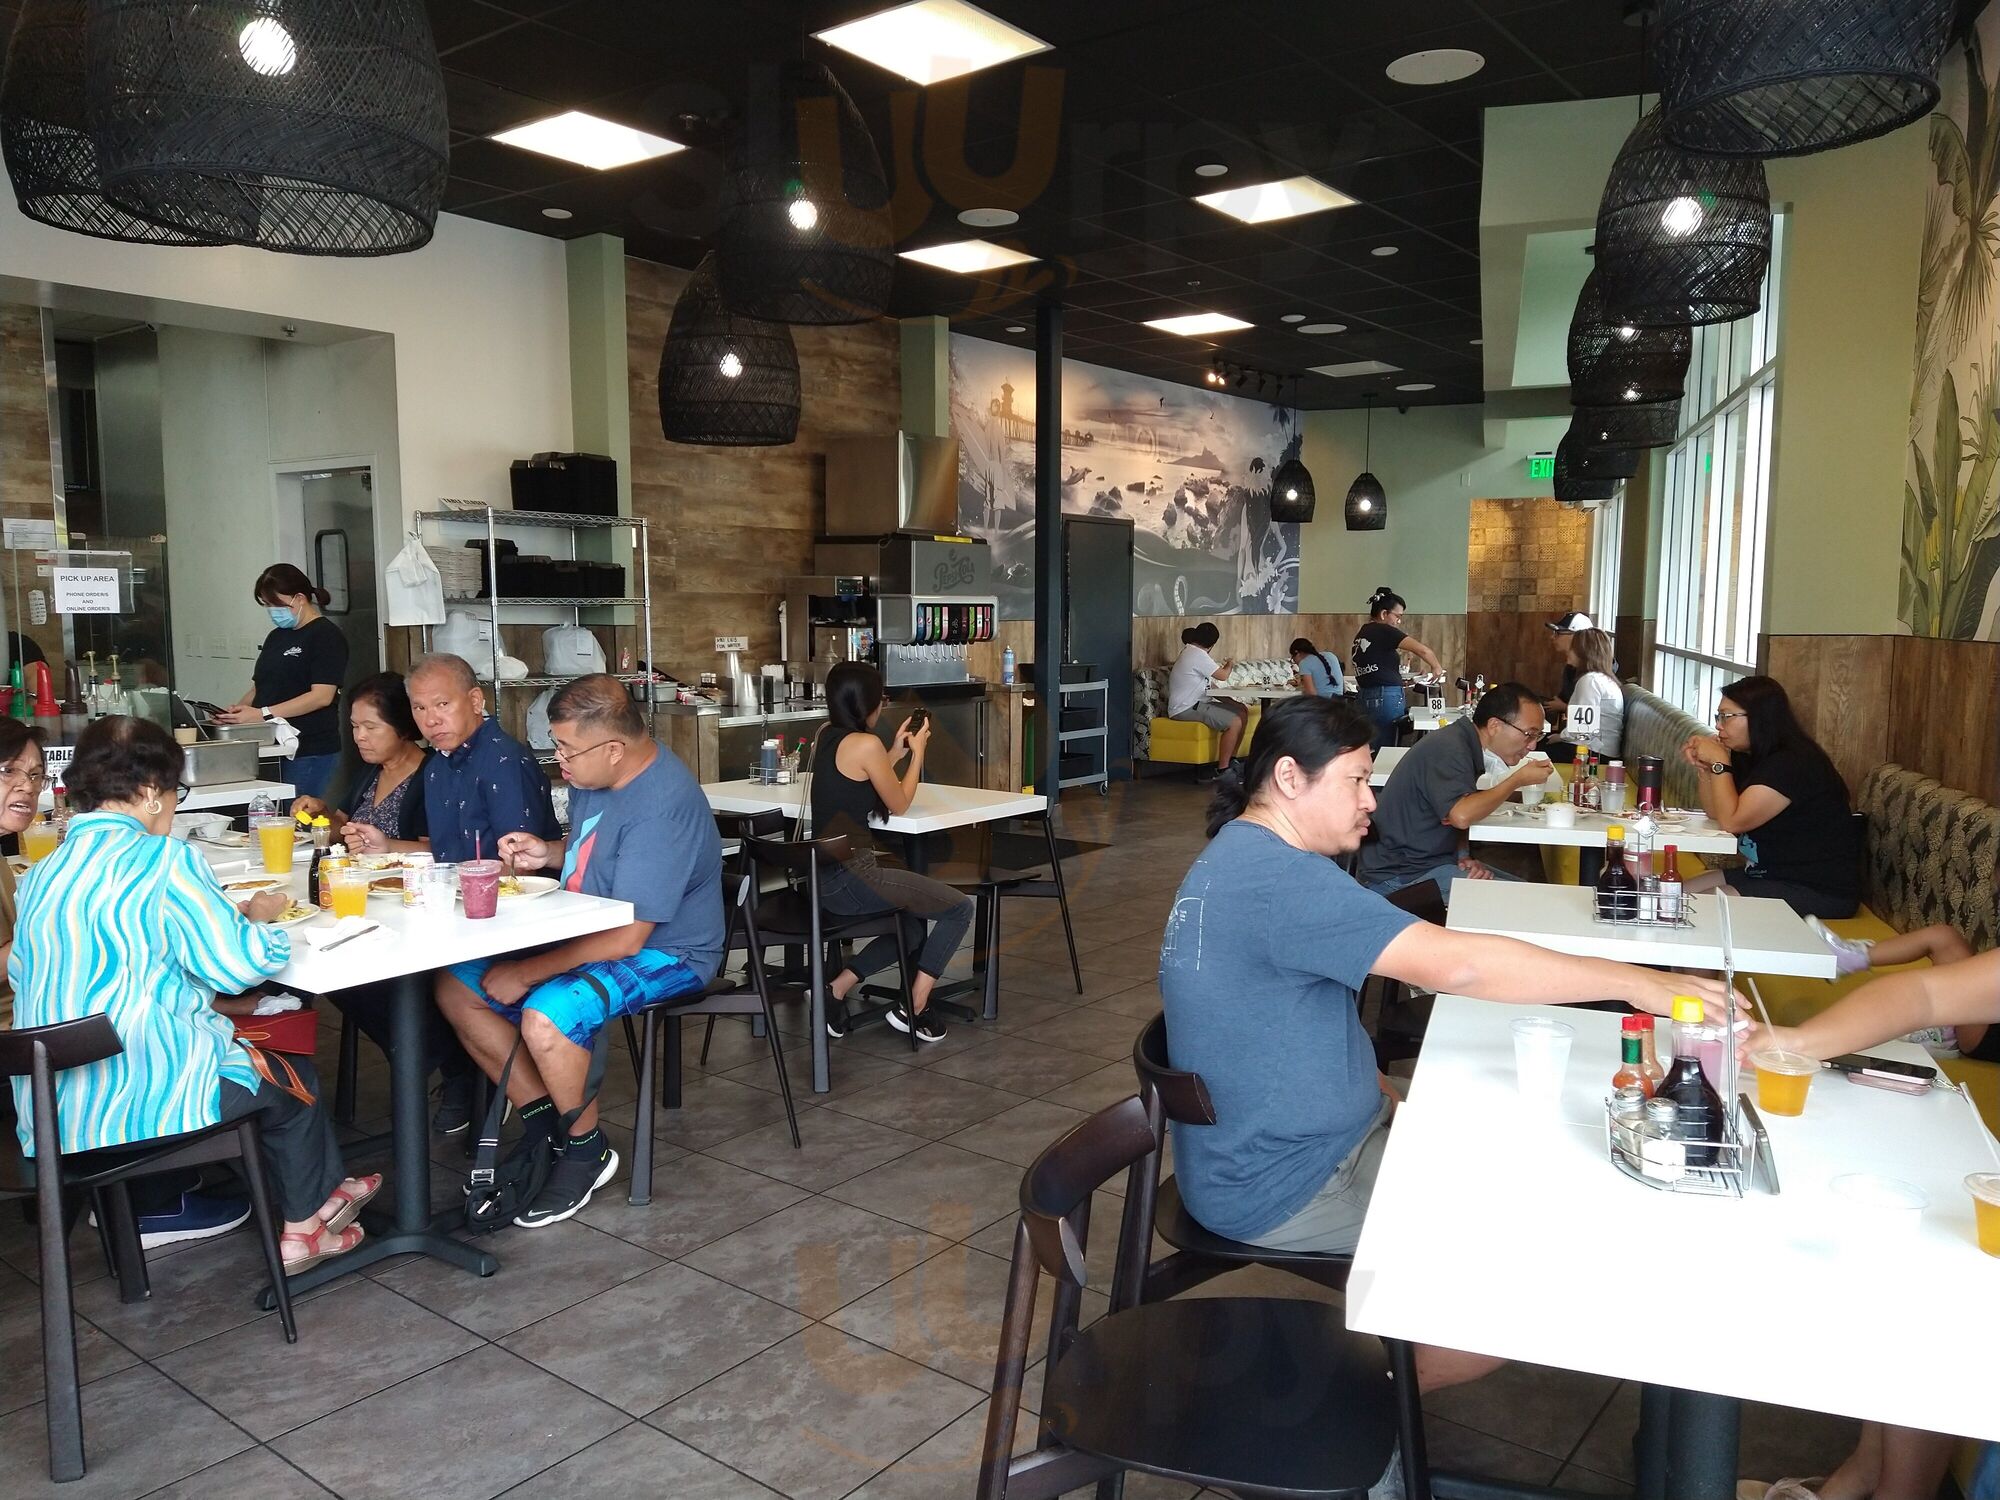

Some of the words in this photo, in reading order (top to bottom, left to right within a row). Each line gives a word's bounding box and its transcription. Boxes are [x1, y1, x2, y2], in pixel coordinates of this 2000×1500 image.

[1531, 459, 1555, 478] EXIT
[1431, 699, 1443, 710] 88
[1573, 707, 1594, 725] 40
